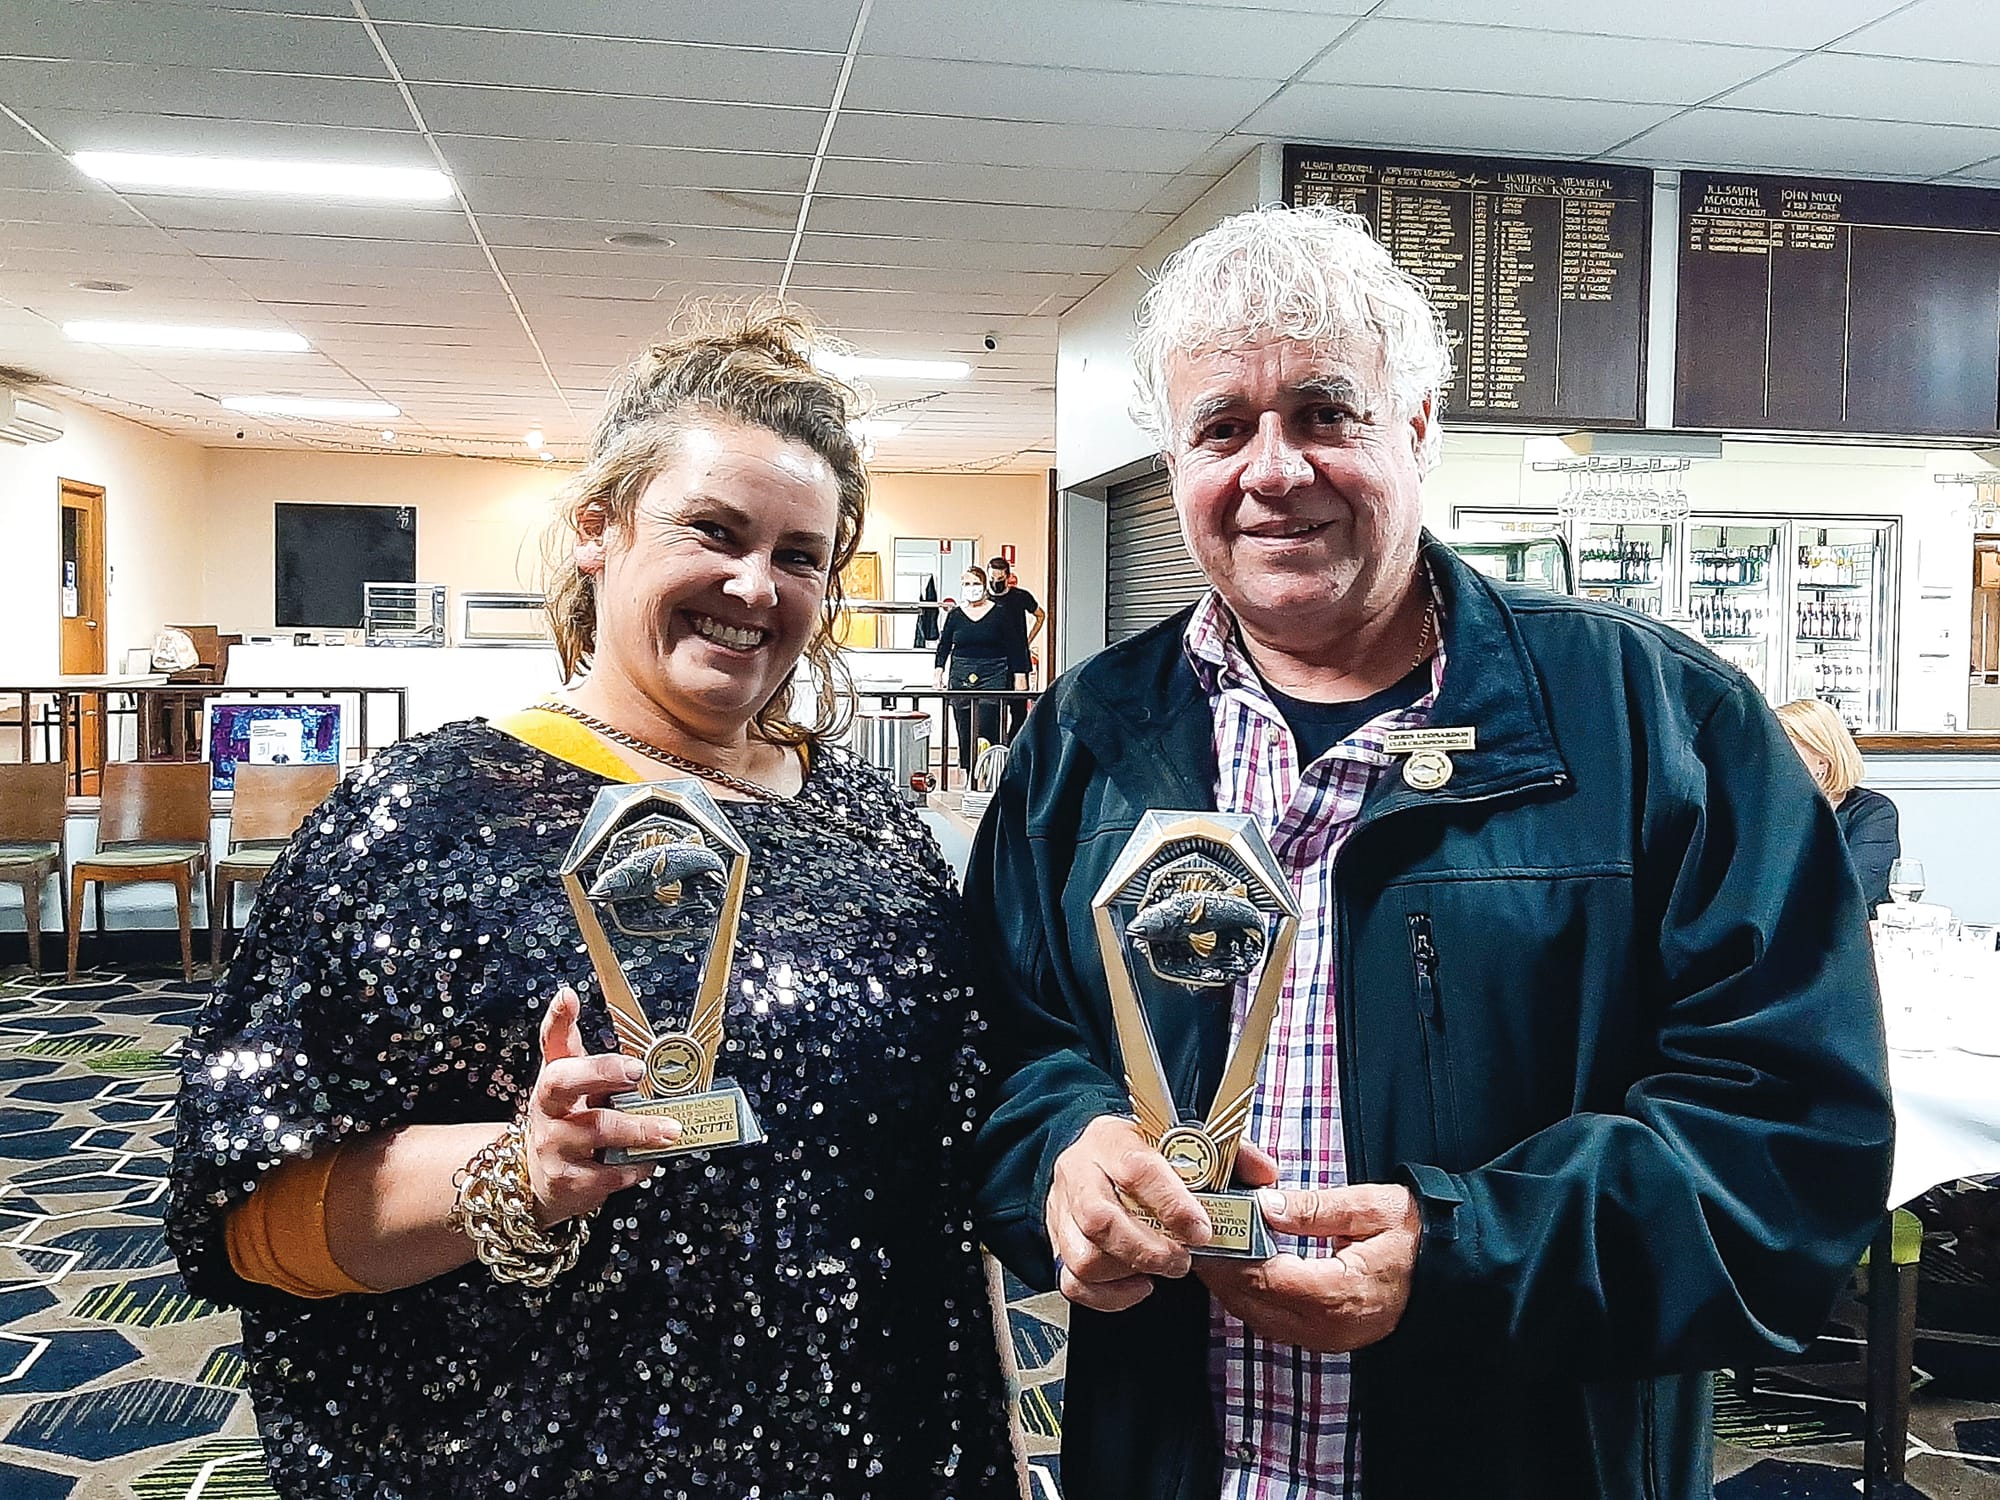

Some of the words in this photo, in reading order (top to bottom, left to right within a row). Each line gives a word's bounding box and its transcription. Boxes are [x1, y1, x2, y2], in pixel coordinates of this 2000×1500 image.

[1552, 186, 1604, 197] KNOCKOUT
[1781, 189, 1808, 201] JOHN
[1703, 195, 1761, 207] MEMORIAL
[694, 1099, 724, 1109] ISLAND
[680, 1120, 735, 1137] NNETTE
[1210, 1217, 1248, 1226] HAMPION
[1210, 1225, 1248, 1237] RDOS
